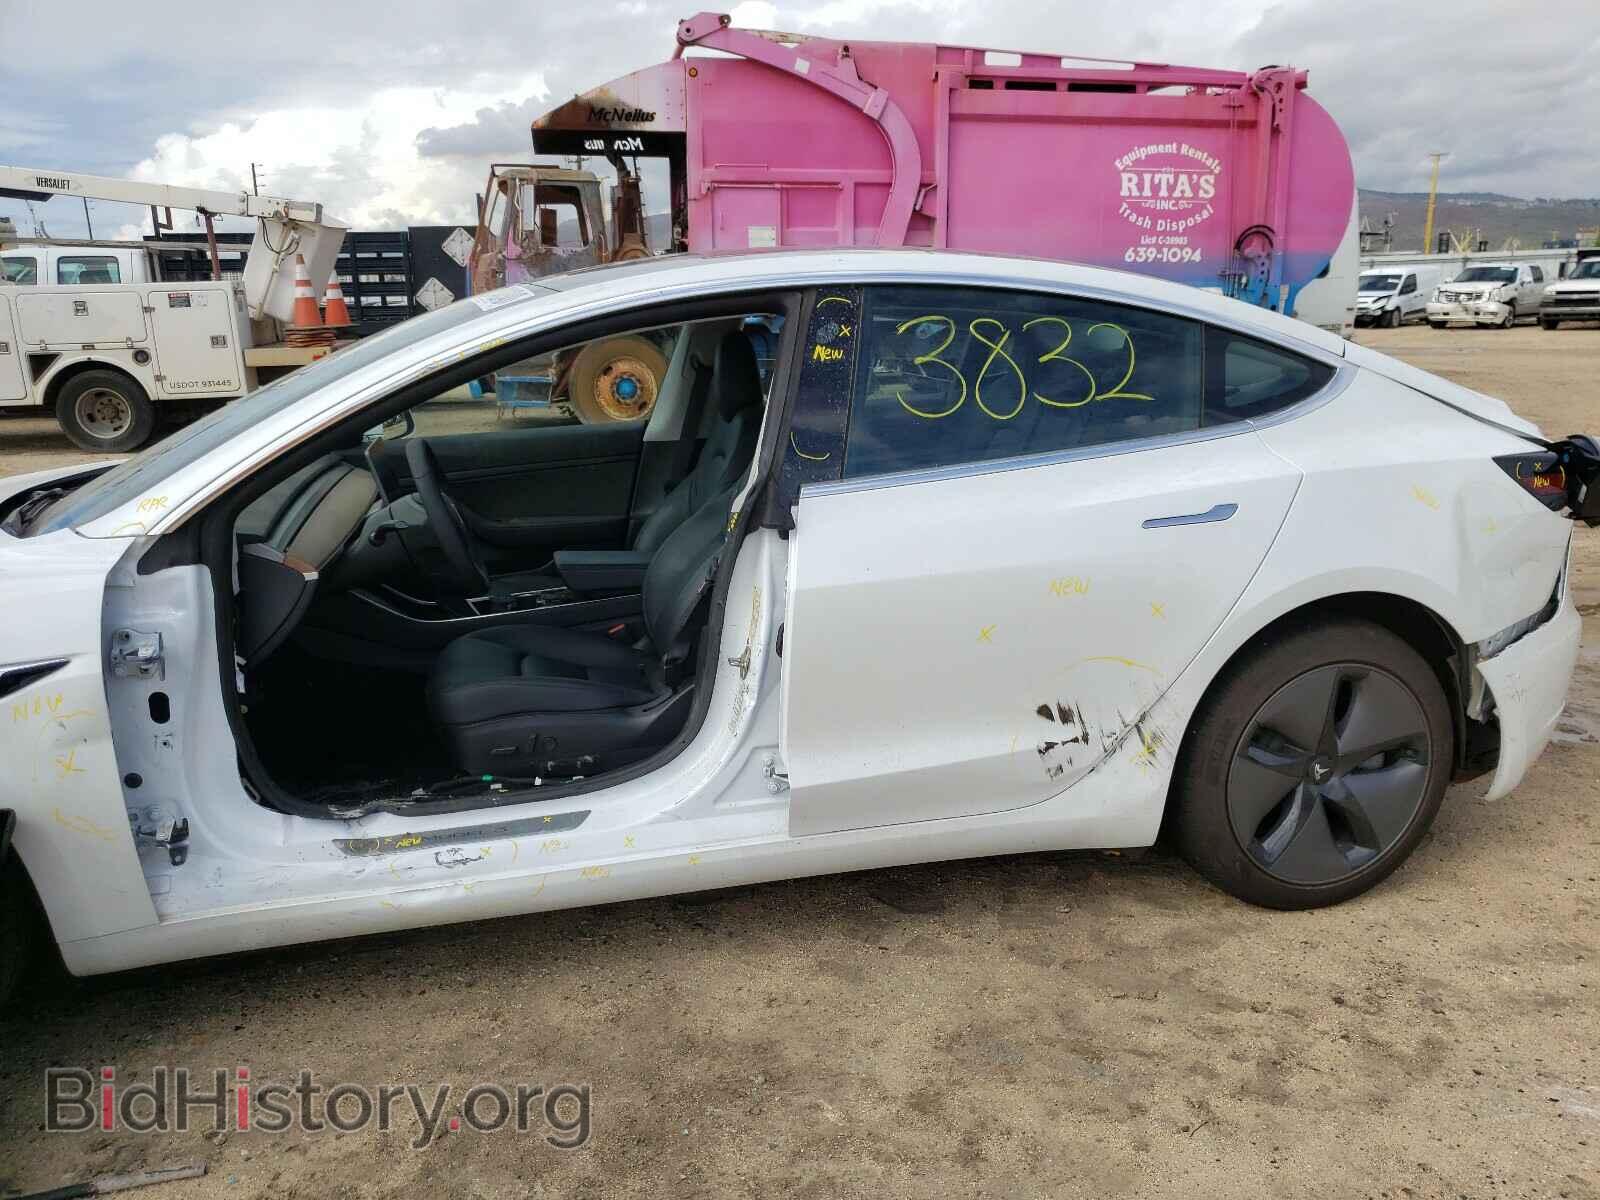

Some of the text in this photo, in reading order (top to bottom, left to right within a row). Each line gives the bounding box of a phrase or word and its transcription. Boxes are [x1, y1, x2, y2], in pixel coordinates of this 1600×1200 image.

[1114, 142, 1222, 174] Equipment Rentals
[36, 176, 71, 191] VERSALIFT
[1120, 173, 1216, 198] RITA'S
[1156, 201, 1178, 210] INC.
[1118, 202, 1214, 233] Trash Disposal
[1124, 247, 1202, 263] 639-1094
[812, 344, 844, 362] New
[896, 315, 1156, 420] 3832
